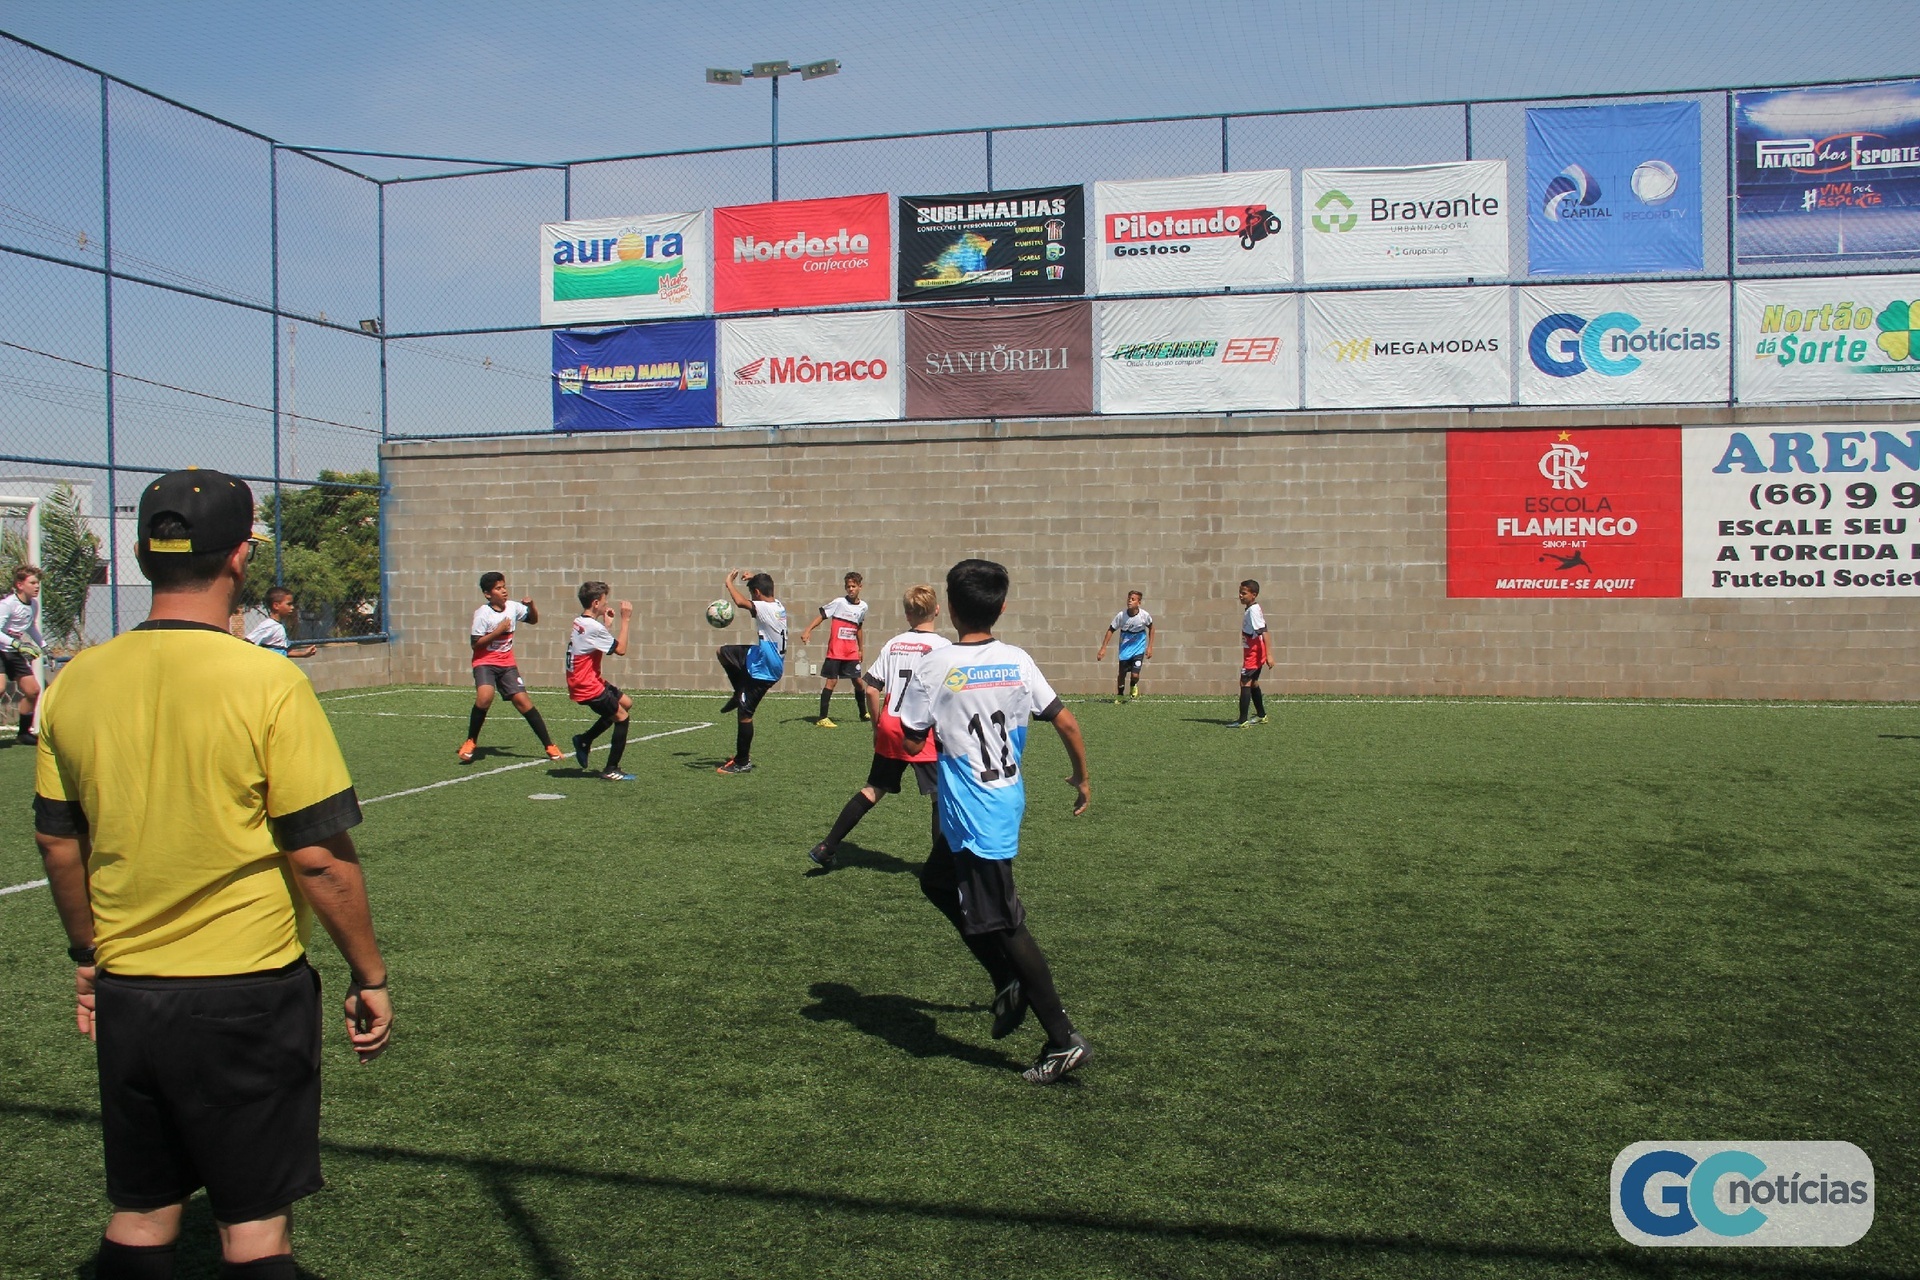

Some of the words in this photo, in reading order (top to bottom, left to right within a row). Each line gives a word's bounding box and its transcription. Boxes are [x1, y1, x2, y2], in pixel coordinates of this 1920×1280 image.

[1756, 139, 1815, 169] PALACIO
[1818, 144, 1848, 162] dos
[1850, 136, 1920, 170] ESPORTE
[916, 198, 1066, 224] SUBLIMALHAS
[1371, 192, 1499, 222] Bravante
[1561, 207, 1613, 219] CAPITAL
[1562, 198, 1579, 208] TV
[963, 220, 1018, 230] PERSONALIZADOS
[1113, 209, 1242, 240] Pilotando
[1390, 222, 1469, 233] URBANIZADORA
[553, 232, 684, 265] aurora
[733, 228, 869, 264] Nordeste
[1114, 244, 1191, 258] Gostoso
[802, 257, 869, 274] Confecções
[1760, 301, 1874, 334] Nortão
[1223, 338, 1279, 363] 22
[1374, 338, 1499, 356] MEGAMODAS
[1611, 327, 1721, 353] notícias
[1756, 338, 1777, 354] dá
[588, 365, 636, 382] BARATO
[637, 361, 682, 381] MANIA
[770, 355, 888, 385] Mônaco
[925, 347, 1069, 375] SANTORELI
[1525, 497, 1612, 513] ESCOLA
[1749, 483, 1832, 510] (66)
[1497, 517, 1639, 537] FLAMENGO
[1718, 518, 1832, 537] ESCALE
[1843, 518, 1907, 535] SEU
[1716, 545, 1740, 562] A
[1750, 543, 1899, 562] TORCIDA
[1496, 578, 1591, 590] MATRICULE-SE
[1593, 578, 1636, 593] AQUI!
[1711, 569, 1826, 588] Futebol
[895, 669, 912, 713] 7
[968, 709, 1017, 783] 12
